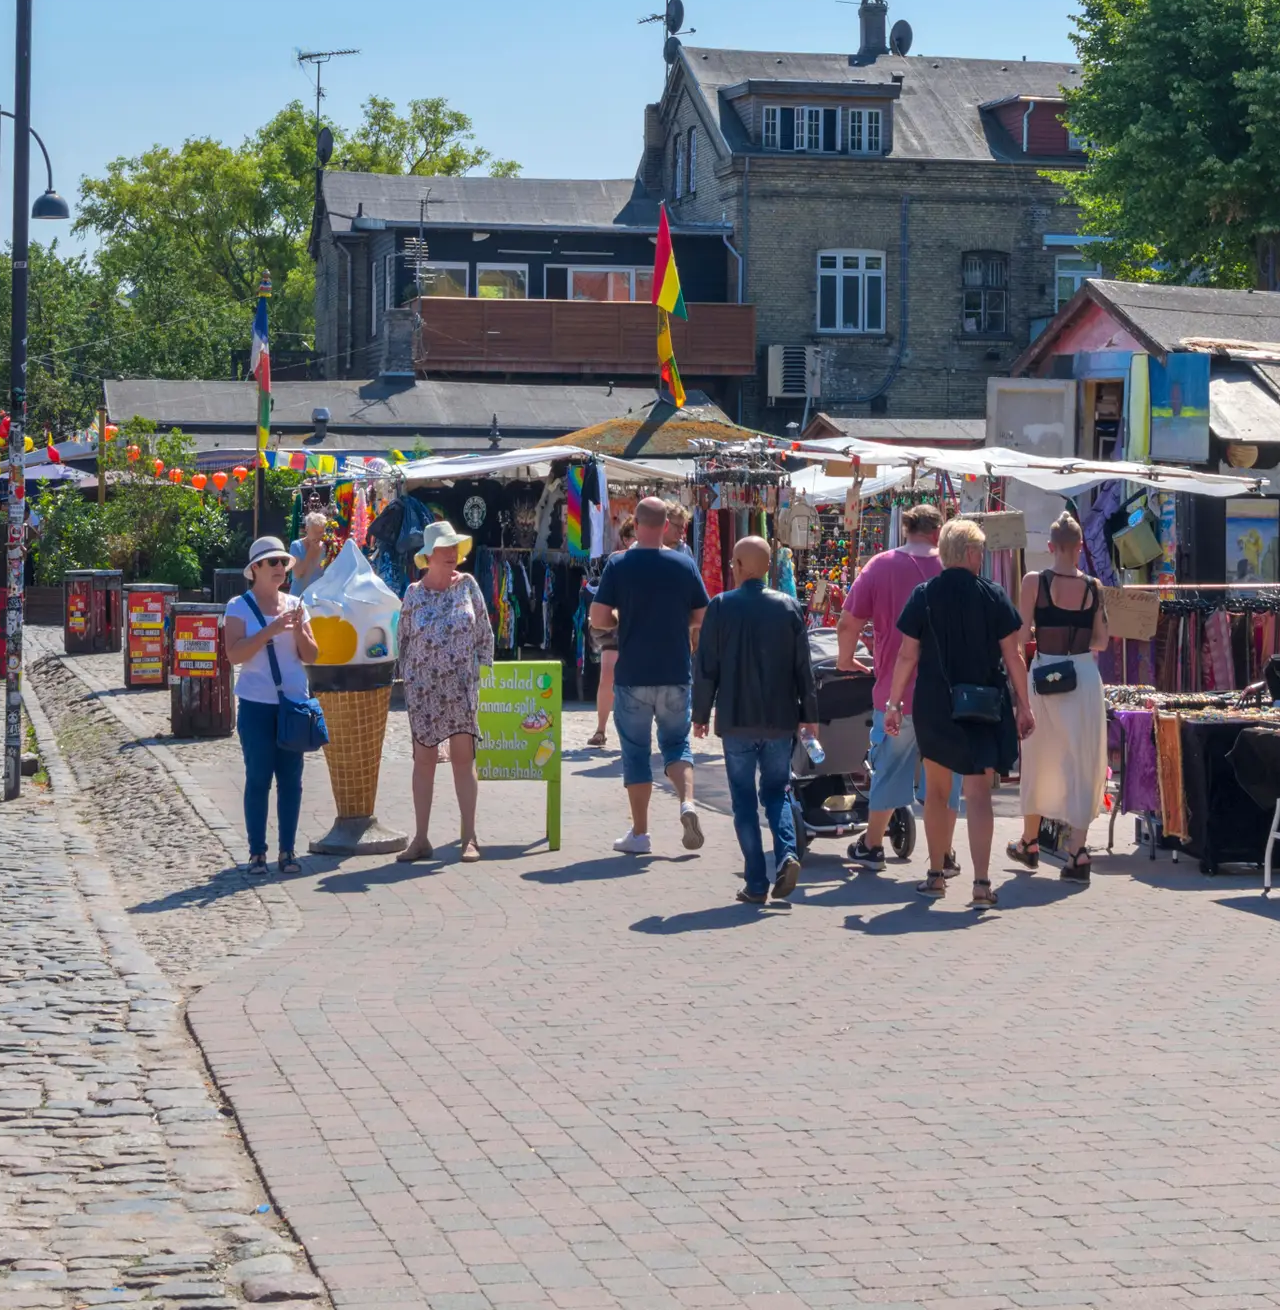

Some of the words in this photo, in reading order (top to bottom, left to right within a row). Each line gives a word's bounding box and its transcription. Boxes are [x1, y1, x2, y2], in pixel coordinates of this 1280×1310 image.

[480, 668, 496, 689] uit
[499, 668, 533, 690] salad
[480, 701, 512, 713] anana
[514, 696, 537, 716] split
[478, 731, 528, 750] ilkshake
[477, 758, 544, 779] roteinshake
